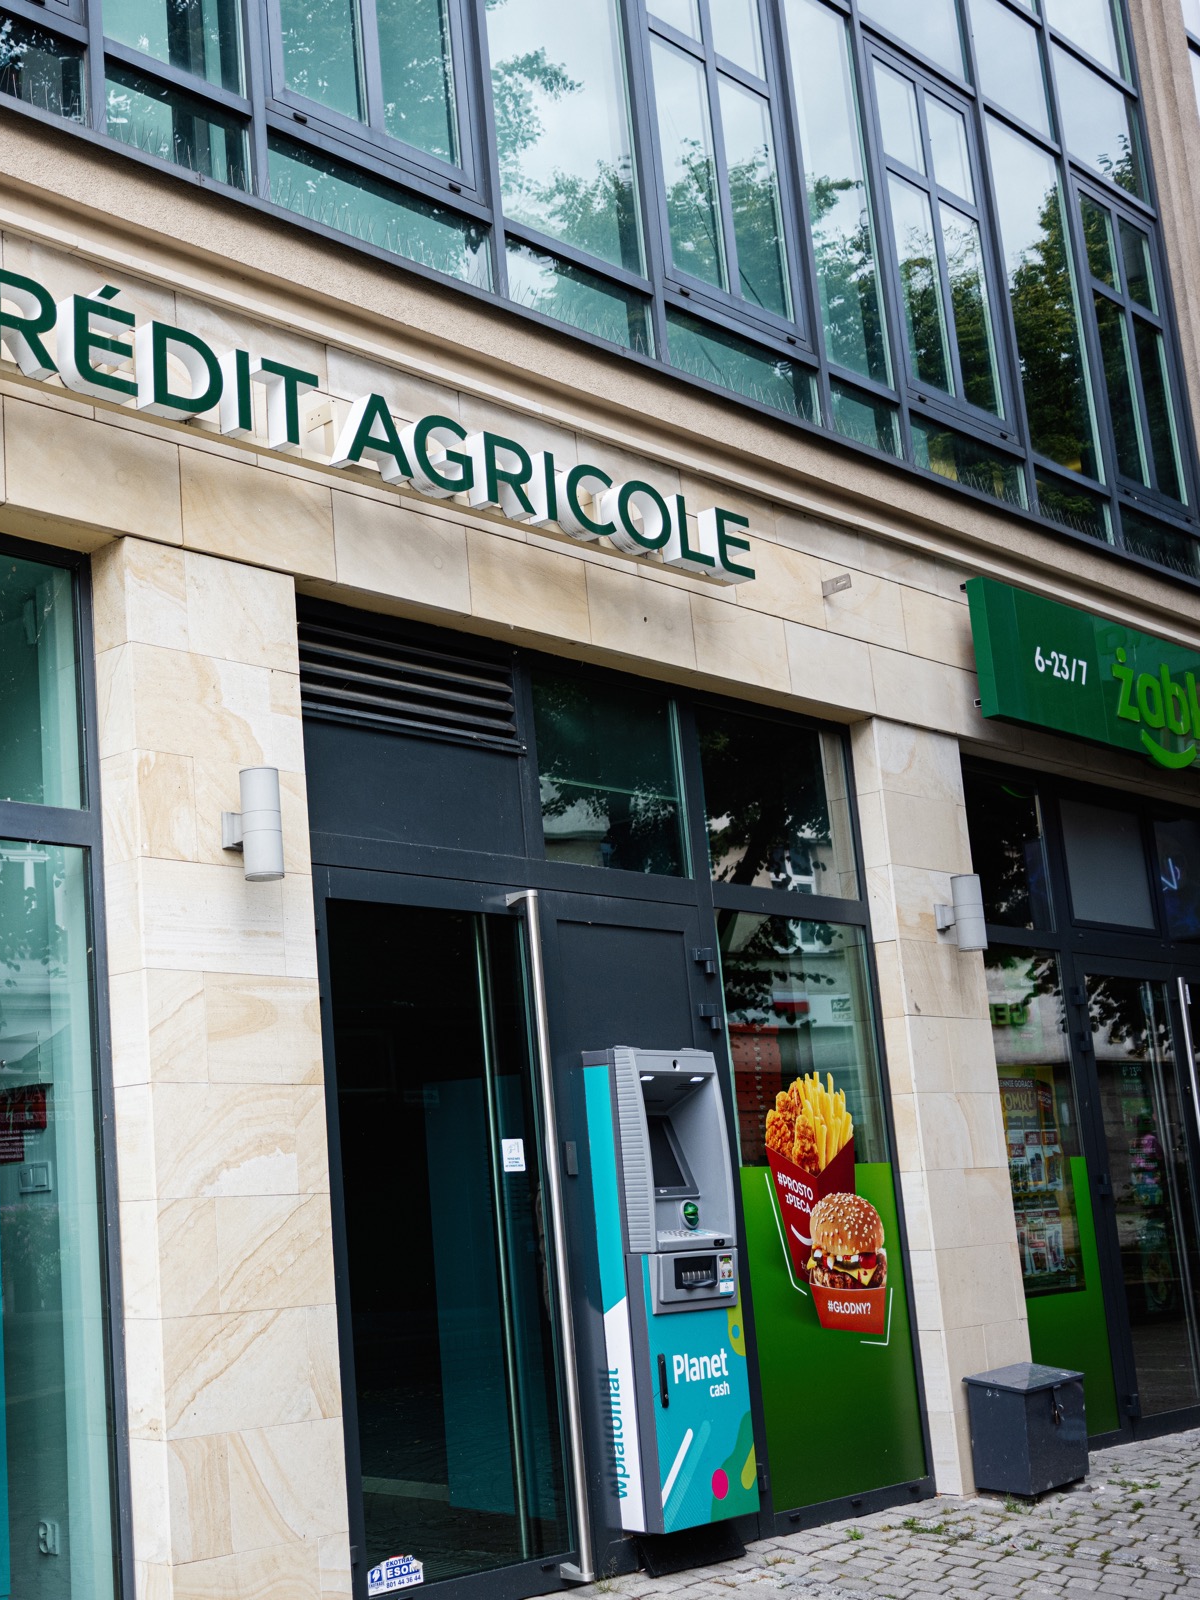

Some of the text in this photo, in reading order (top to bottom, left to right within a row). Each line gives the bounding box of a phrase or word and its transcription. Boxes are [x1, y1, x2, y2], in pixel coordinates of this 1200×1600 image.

[336, 392, 756, 581] AGRICOLE
[1034, 646, 1088, 686] 6-23/7
[776, 1171, 814, 1201] #PROSTO
[827, 1299, 872, 1315] #GŁODNY?
[672, 1348, 729, 1385] Planet
[709, 1381, 730, 1398] cash
[386, 1581, 396, 1589] 801
